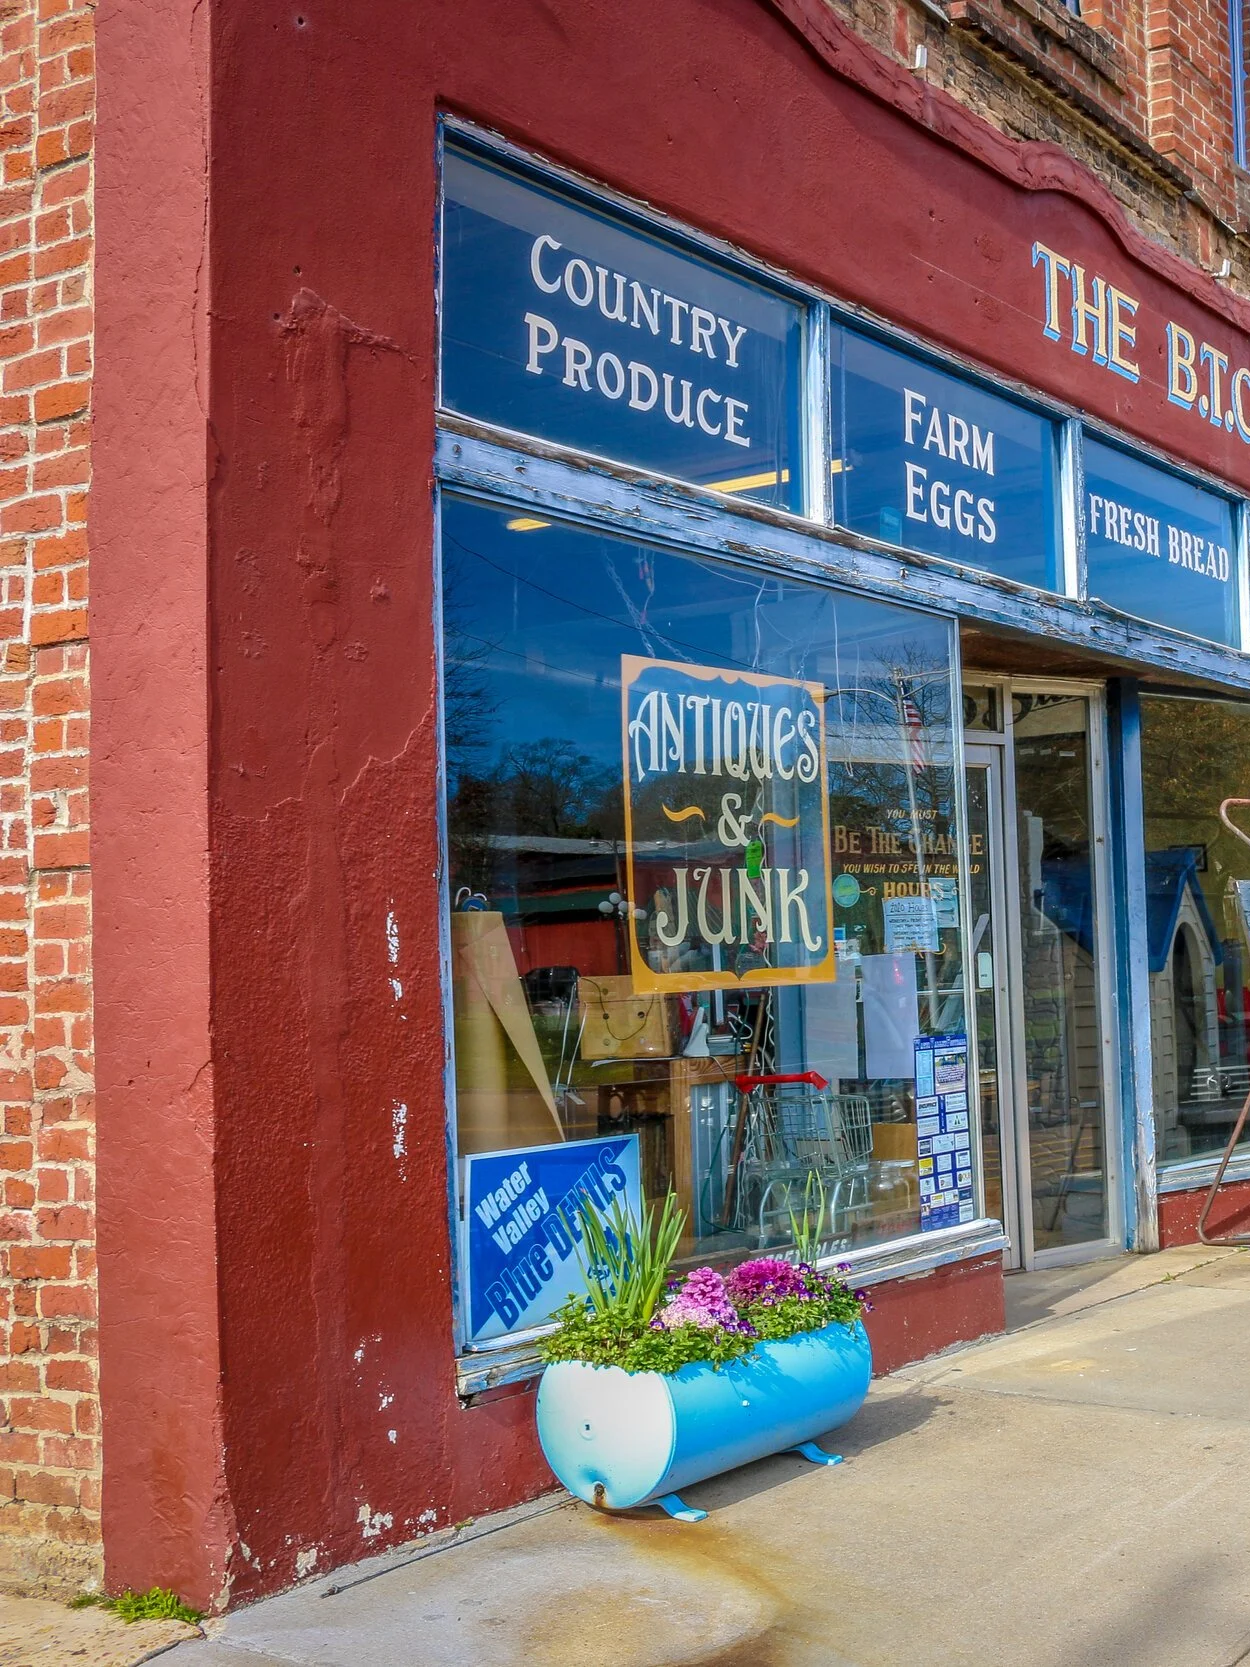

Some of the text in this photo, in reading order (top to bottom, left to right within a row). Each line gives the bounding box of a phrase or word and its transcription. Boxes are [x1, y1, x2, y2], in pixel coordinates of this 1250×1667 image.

[531, 234, 747, 368] COUNTRY
[1032, 241, 1140, 384] THE
[524, 312, 750, 448] PRODUCE
[904, 388, 995, 476] FARM
[905, 461, 996, 543] EGGS
[1090, 493, 1229, 582] FRESH BREAD
[629, 691, 819, 783] ANTIQUES
[718, 793, 753, 847] &
[834, 825, 861, 854] BE
[866, 826, 902, 854] THE
[887, 809, 937, 819] YOU MUST
[656, 867, 822, 952] JUNK
[843, 864, 860, 874] YOU
[863, 864, 886, 873] WISH
[888, 864, 900, 873] TO
[934, 864, 950, 874] THE
[884, 881, 944, 901] HOURS
[475, 1161, 532, 1229] Water
[492, 1187, 550, 1255] Valley
[485, 1243, 554, 1330] Blue
